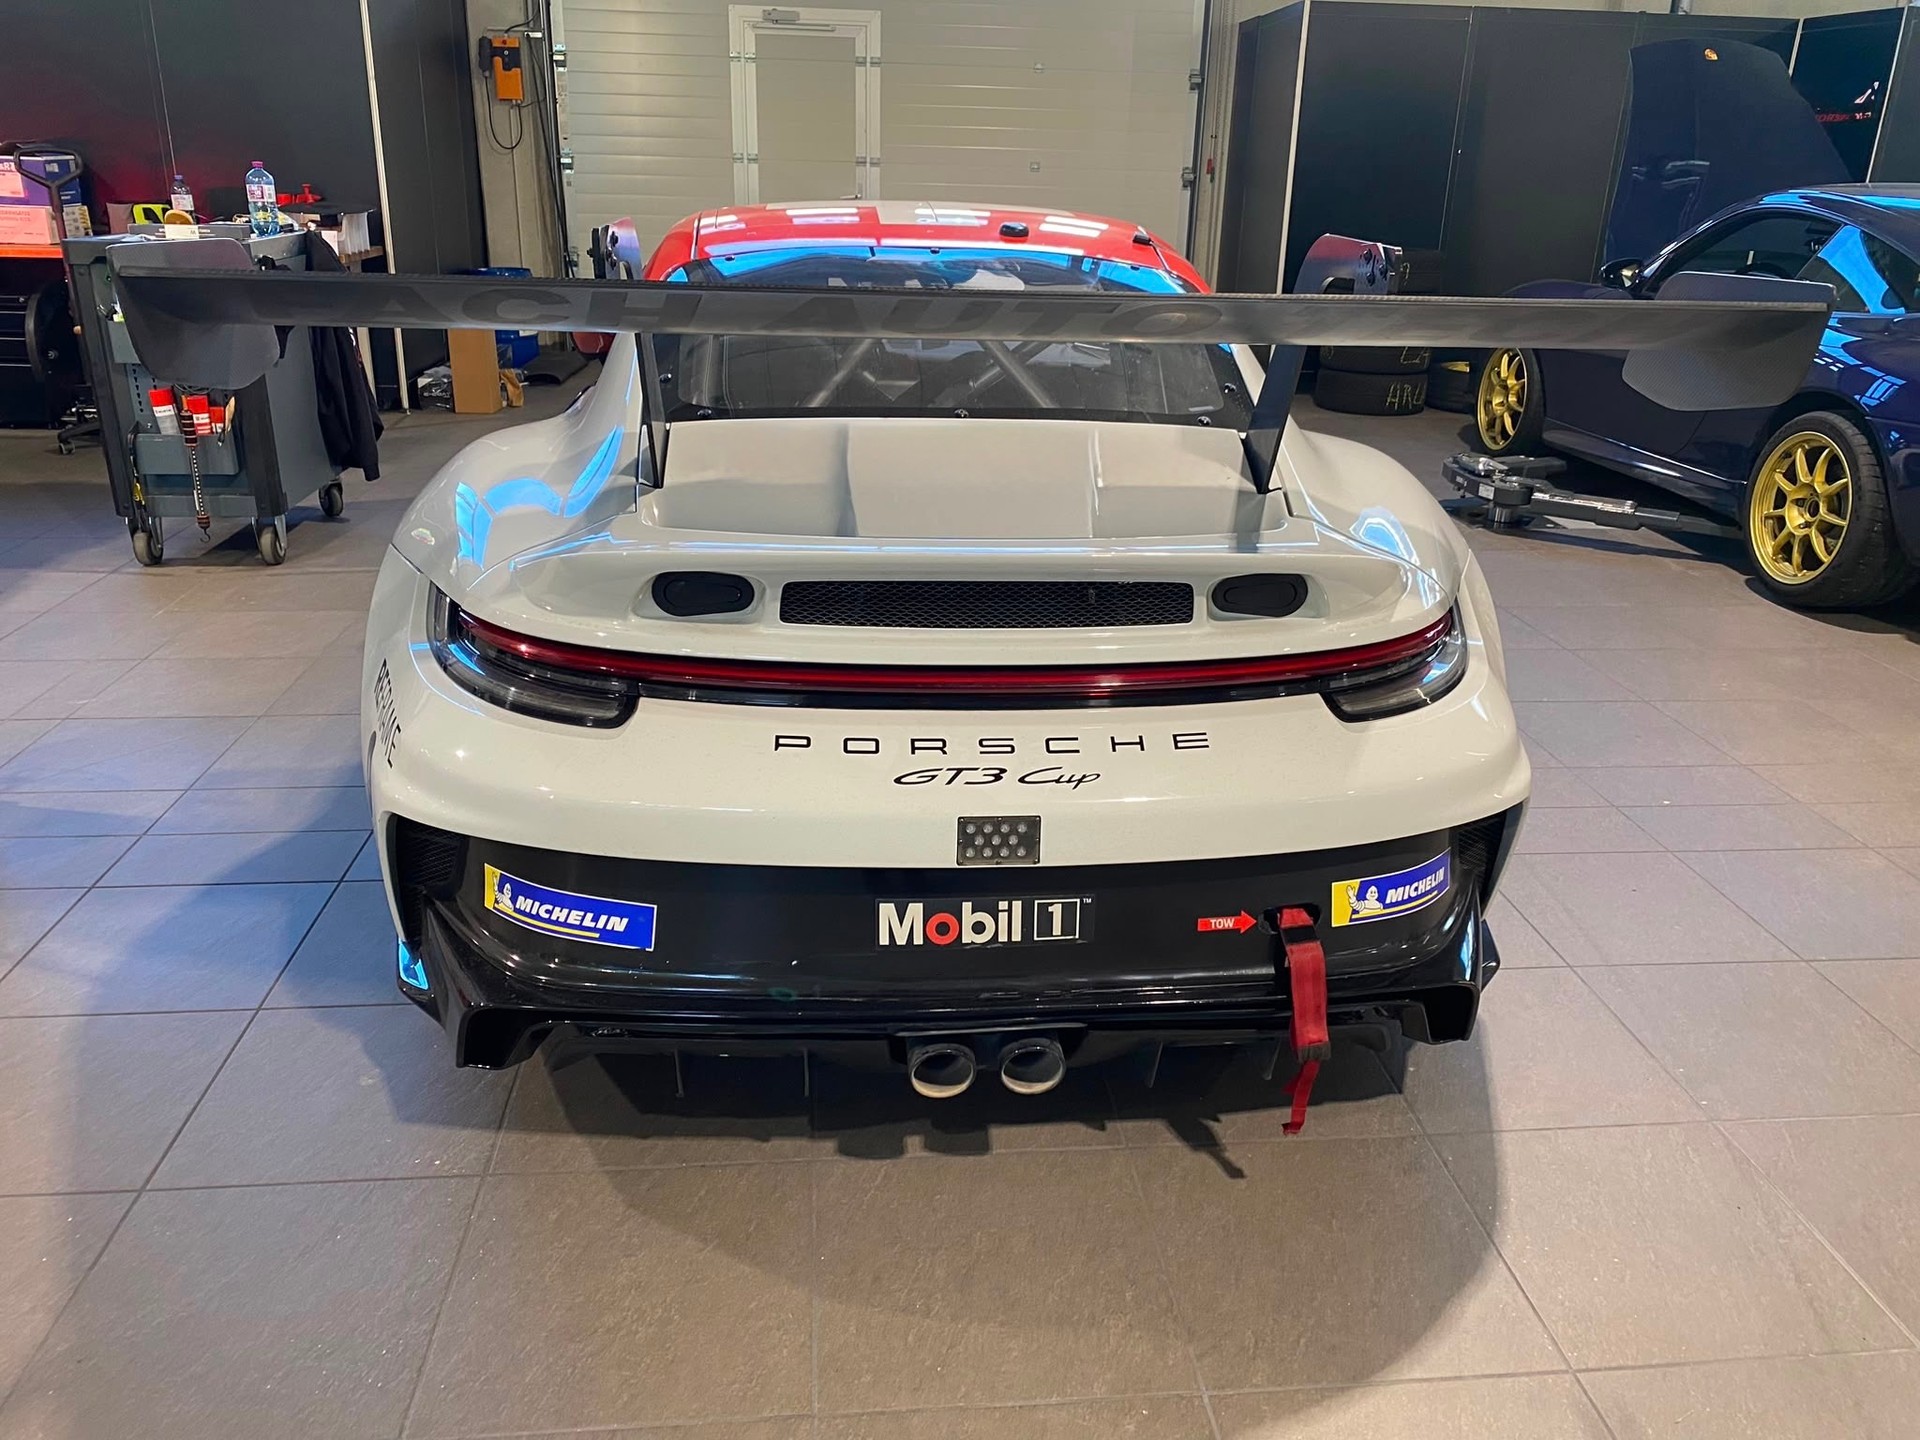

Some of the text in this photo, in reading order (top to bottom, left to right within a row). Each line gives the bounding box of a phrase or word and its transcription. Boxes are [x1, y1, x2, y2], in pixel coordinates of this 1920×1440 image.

[374, 658, 401, 769] REFRAME
[774, 732, 1210, 755] PORSCHE
[893, 766, 1101, 790] GT3 Cup
[1385, 866, 1445, 905] MICHELIN
[515, 895, 629, 933] MICHELIN
[878, 900, 1022, 946] Mobil
[1209, 918, 1235, 930] TOW
